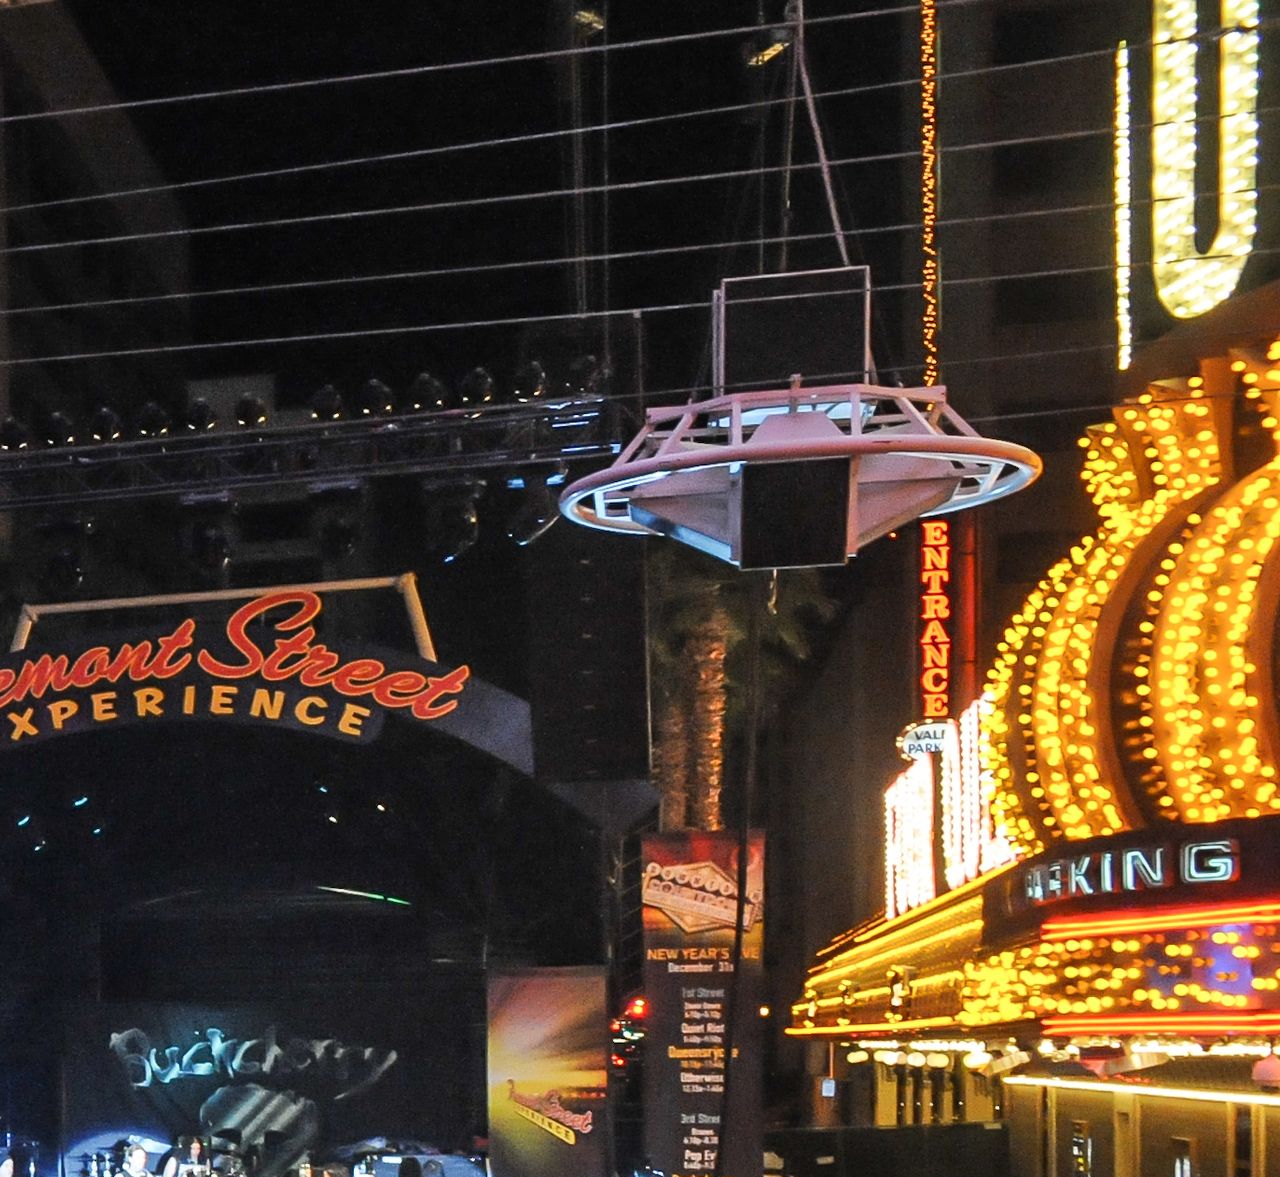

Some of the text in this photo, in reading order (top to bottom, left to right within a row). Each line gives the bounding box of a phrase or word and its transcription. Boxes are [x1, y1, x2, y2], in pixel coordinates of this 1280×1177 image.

[920, 519, 951, 718] ENTRANCE
[197, 590, 470, 720] Street
[914, 729, 945, 741] VAL
[908, 743, 943, 754] PARK
[646, 948, 679, 960] NEW
[682, 947, 730, 960] YEAR'S
[667, 1045, 740, 1061] Queensryce
